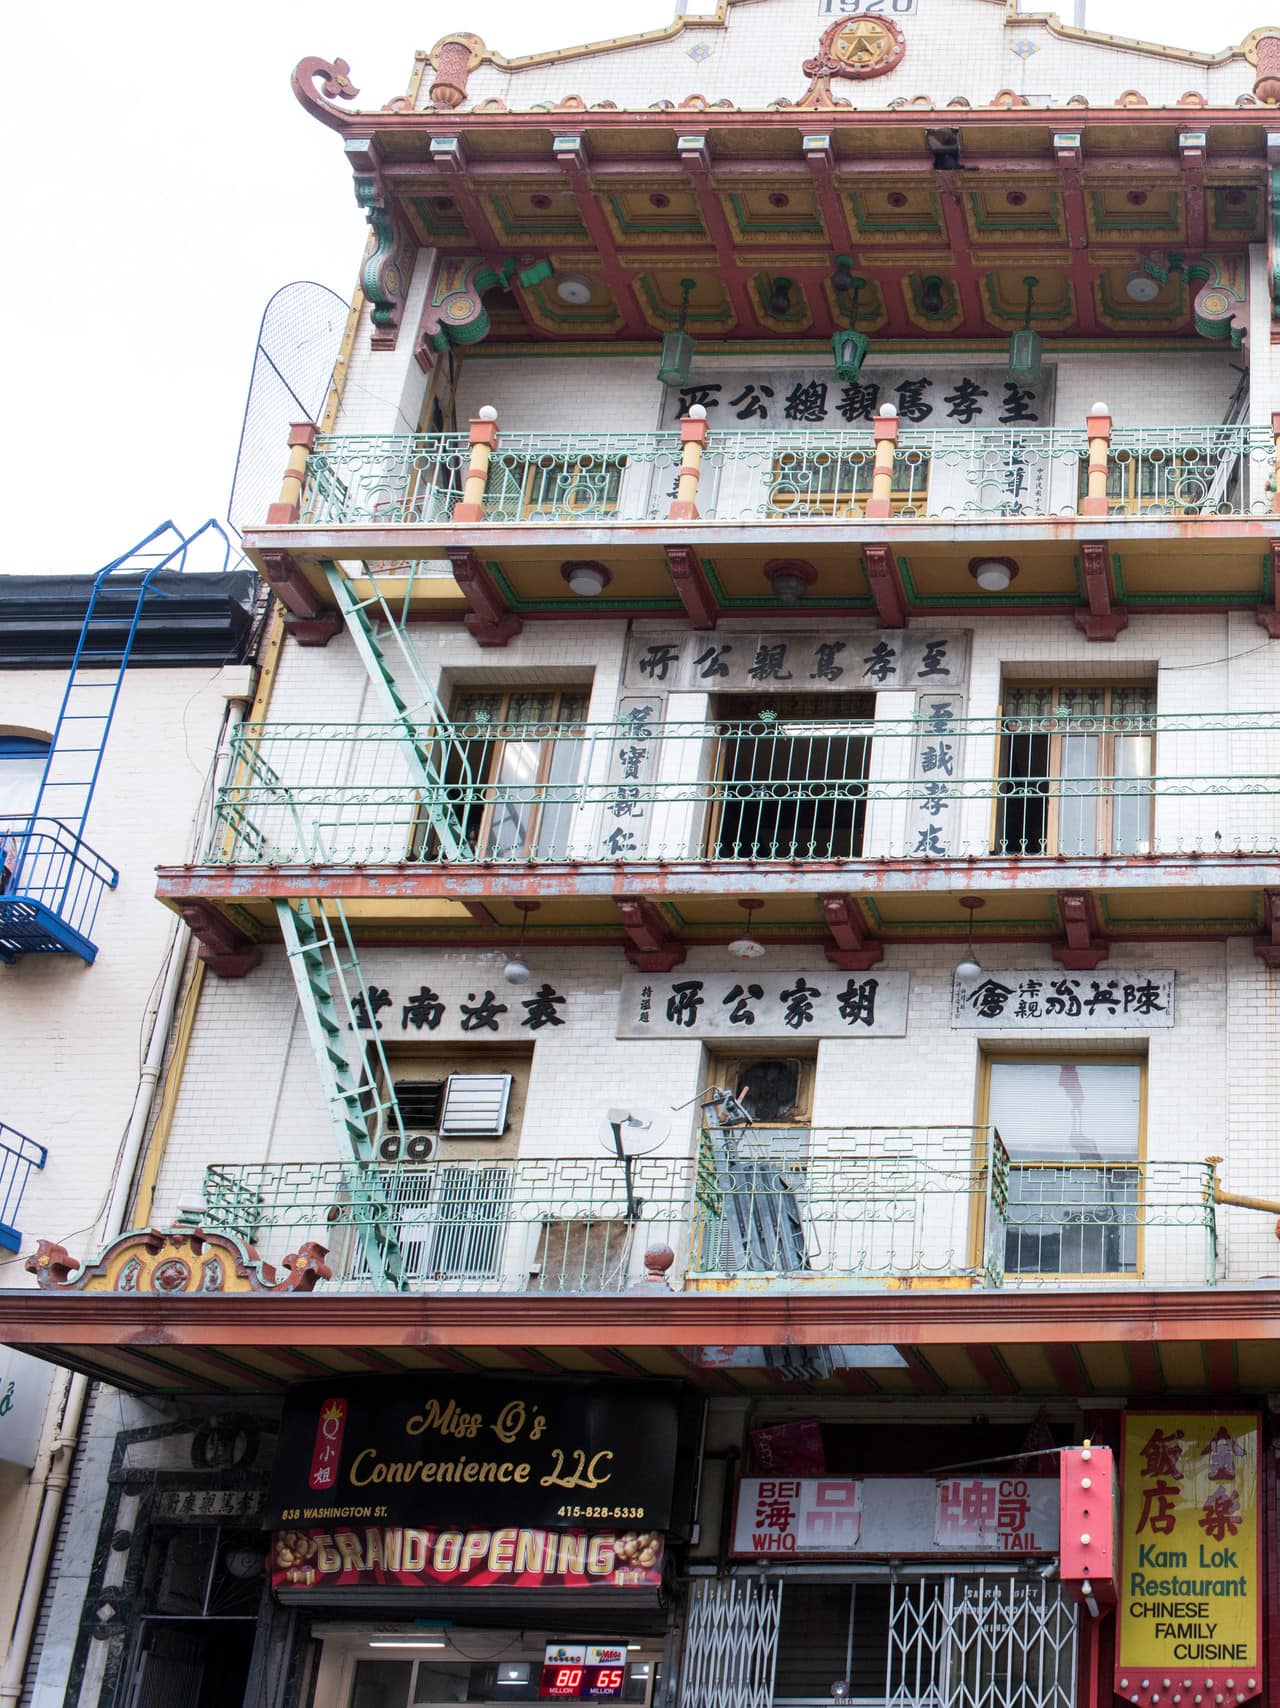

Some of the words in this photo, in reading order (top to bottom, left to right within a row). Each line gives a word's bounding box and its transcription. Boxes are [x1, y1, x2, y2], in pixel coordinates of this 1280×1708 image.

[639, 639, 951, 682] 至孝篤親公所
[666, 977, 879, 1029] 胡家公所
[406, 1399, 483, 1438] Miss
[490, 1400, 547, 1443] Q's
[349, 1448, 531, 1487] Convenience
[539, 1449, 614, 1489] LLC
[999, 1480, 1030, 1498] CO.
[1136, 1428, 1185, 1535] 飯店
[282, 1508, 300, 1520] 838
[303, 1506, 372, 1519] WASHINGTON
[375, 1506, 388, 1518] ST.
[557, 1506, 645, 1519] 415-828-5338
[998, 1533, 1042, 1550] TAIL
[316, 1528, 429, 1573] GRAND
[433, 1528, 616, 1575] OPENING
[1139, 1544, 1187, 1568] Kam
[1199, 1544, 1239, 1568] Lok
[1130, 1572, 1247, 1597] Restaurant
[1129, 1602, 1209, 1618] CHINESE
[1155, 1623, 1217, 1639] FAMILY
[1174, 1643, 1247, 1660] CUISINE
[556, 1670, 582, 1687] 80
[597, 1670, 623, 1688] 65
